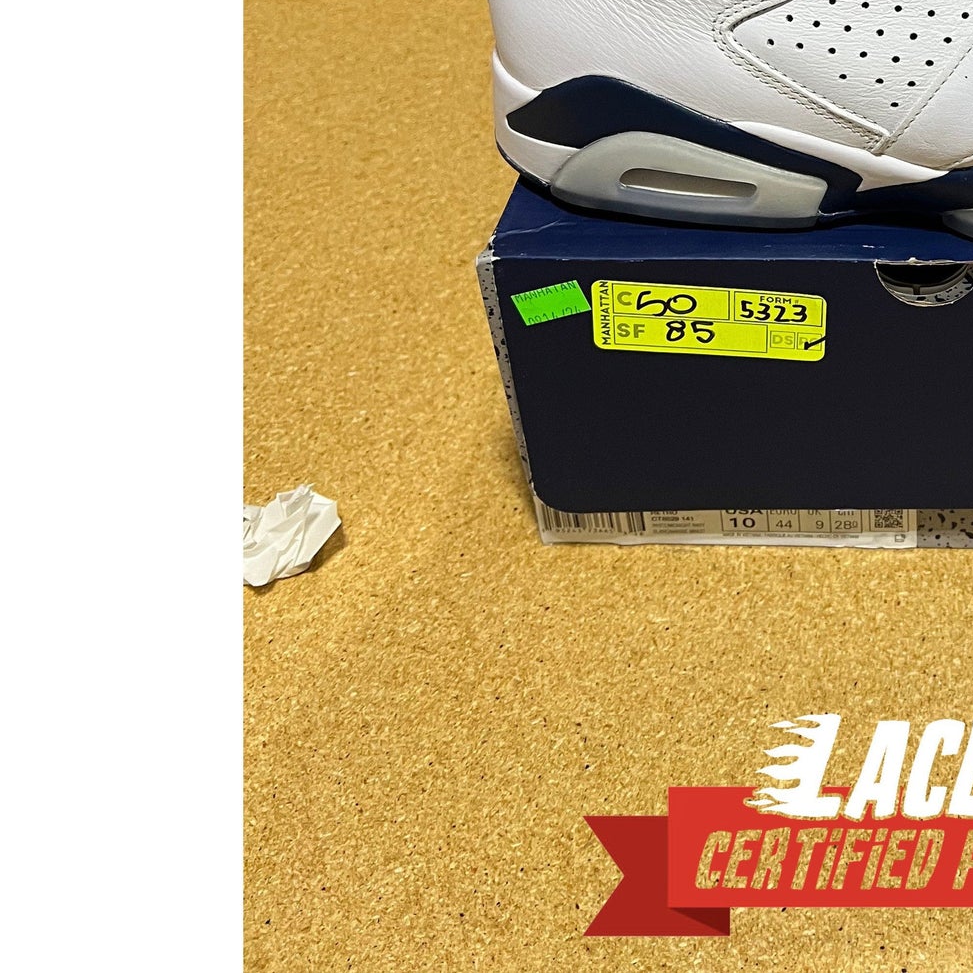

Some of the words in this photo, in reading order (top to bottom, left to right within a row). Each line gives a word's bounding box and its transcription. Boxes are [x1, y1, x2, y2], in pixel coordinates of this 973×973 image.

[617, 291, 632, 306] C
[636, 291, 697, 316] 50
[740, 300, 807, 322] 5323
[760, 296, 792, 304] FORM
[599, 281, 611, 345] MANHATTAN
[617, 323, 645, 338] SF
[666, 320, 715, 343] 85
[772, 335, 794, 345] DS
[729, 517, 756, 528] 10
[775, 520, 792, 529] 44
[815, 520, 825, 530] 9
